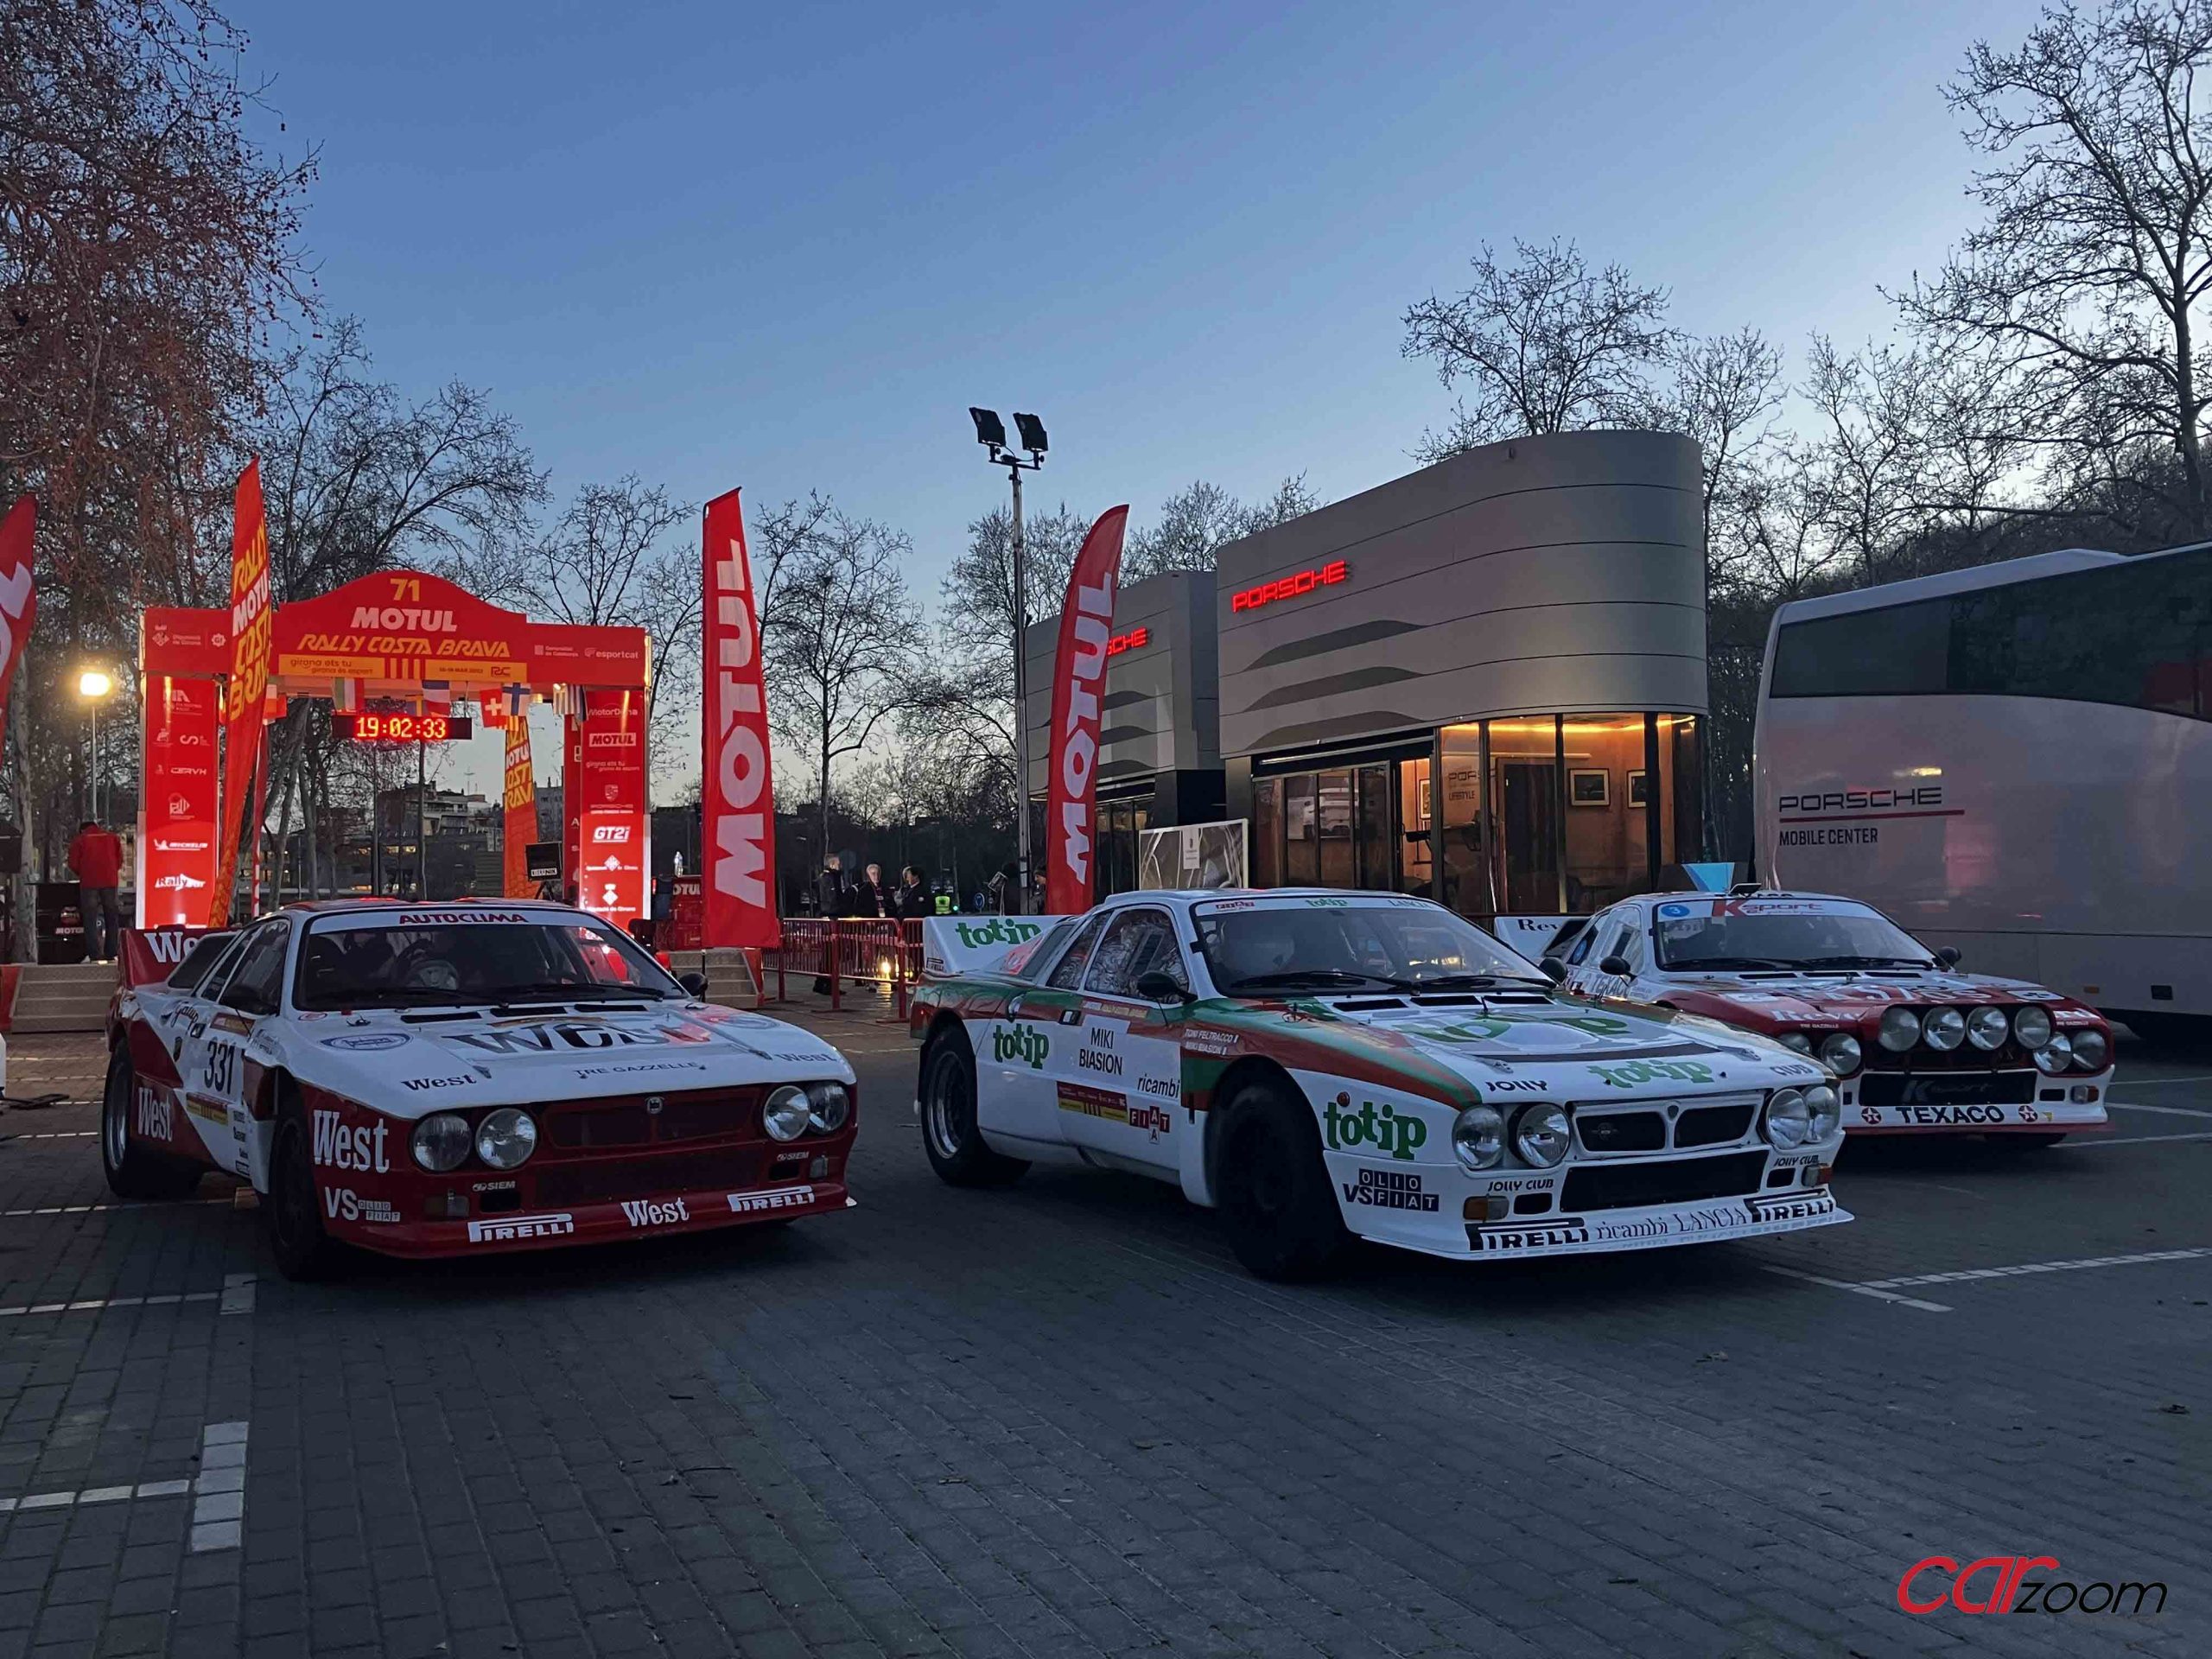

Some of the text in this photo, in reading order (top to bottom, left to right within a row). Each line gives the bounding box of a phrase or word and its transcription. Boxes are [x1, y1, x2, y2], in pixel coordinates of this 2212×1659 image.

[391, 578, 420, 601] 71
[1232, 560, 1346, 613] PORSCHE
[232, 567, 269, 637] MOTU
[350, 607, 458, 632] MOTUL
[297, 633, 510, 658] RALLY COSTA BRAVA
[1108, 626, 1147, 655] SCHE
[596, 650, 639, 659] esportcat
[355, 716, 447, 738] 19:02:33
[715, 538, 766, 909] MOTUL
[1062, 572, 1112, 885] MOTUL
[591, 734, 635, 746] MOTUL
[1779, 787, 1942, 812] PORSCHE
[594, 826, 631, 840] GT2i
[1779, 828, 1878, 846] MOBILE CENTER
[399, 913, 529, 925] AUTOCLIMA
[143, 931, 200, 963] We
[994, 1023, 1050, 1070] totip
[1090, 1027, 1115, 1050] MIKI
[204, 1037, 236, 1095] 331
[613, 1062, 697, 1073] GAZZELLE
[775, 1053, 837, 1064] West
[1079, 1048, 1122, 1076] BIASION
[401, 1074, 478, 1092] West
[1137, 1073, 1179, 1099] ricambi
[1586, 1059, 1714, 1089] totip
[138, 1087, 173, 1142] West
[1896, 1105, 2005, 1124] TEXACO
[313, 1109, 390, 1173] West
[1323, 1101, 1427, 1160] totip
[487, 1181, 516, 1191] SIEM
[1360, 1169, 1421, 1192] OLIO
[1488, 1179, 1554, 1192] JOLLY CLUB
[325, 1186, 359, 1221] VS
[728, 1185, 815, 1211] PIRELLI
[1343, 1183, 1436, 1210] VS FIAT
[1743, 1188, 1834, 1224] PIRELLI
[366, 1211, 401, 1222] FIAT
[621, 1197, 690, 1227] West
[1597, 1207, 1747, 1240] ricambi LANCIA
[467, 1212, 575, 1243] PIRELLI
[1464, 1217, 1590, 1251] PIRELLI
